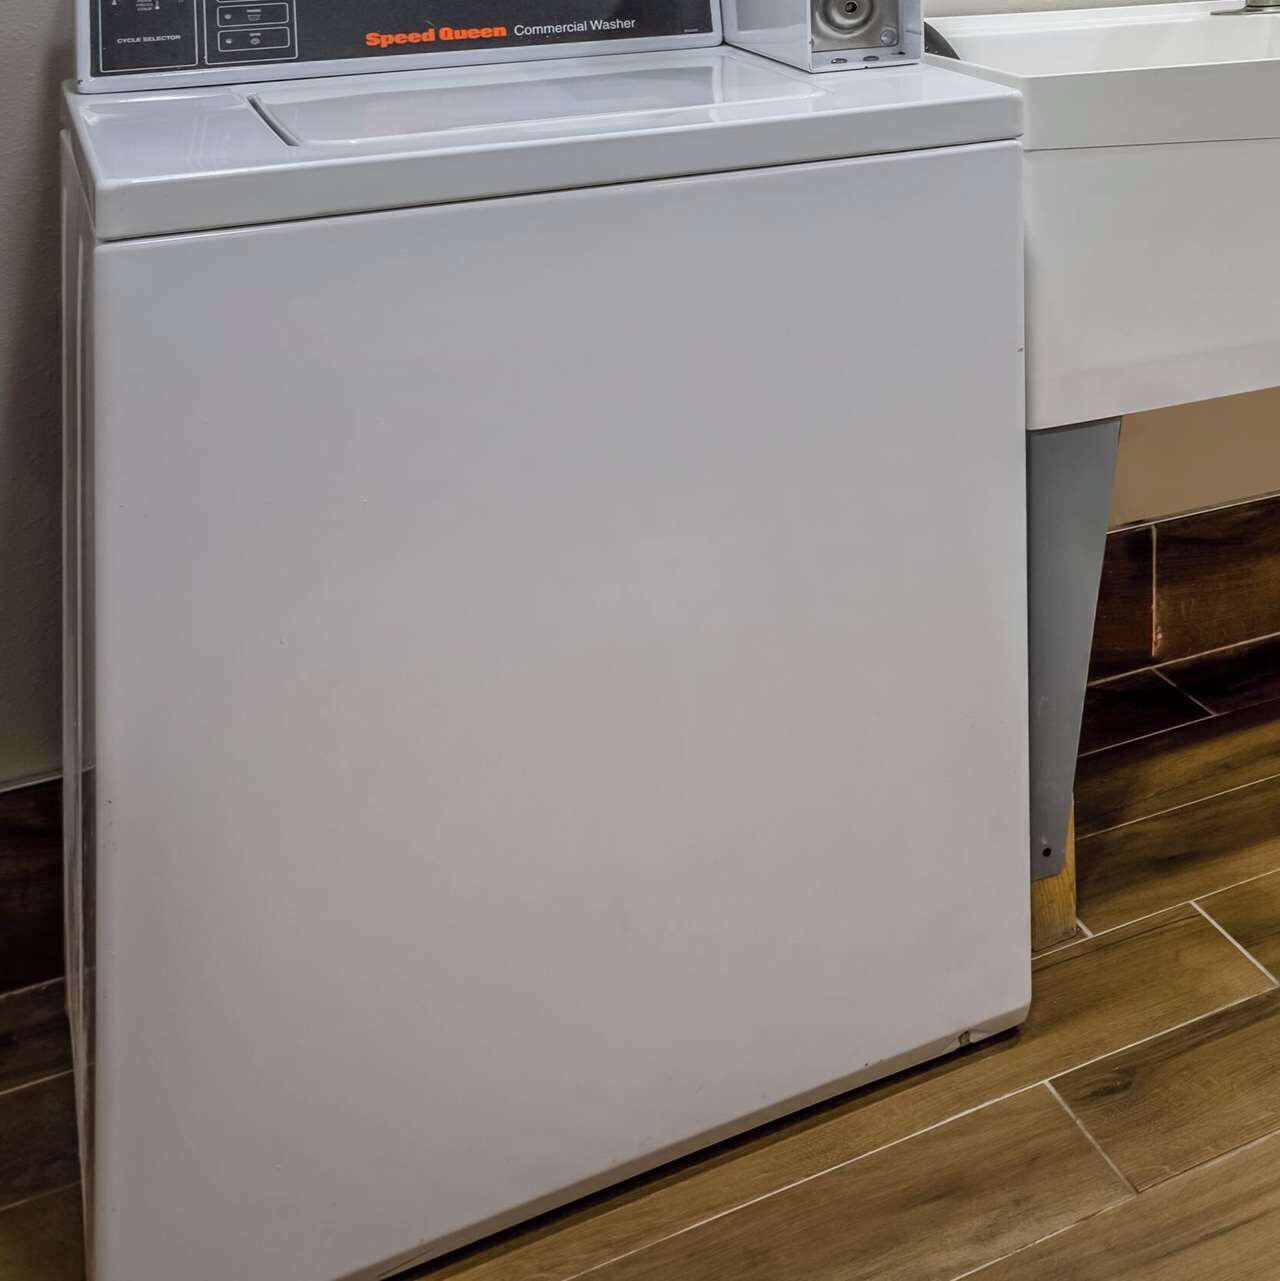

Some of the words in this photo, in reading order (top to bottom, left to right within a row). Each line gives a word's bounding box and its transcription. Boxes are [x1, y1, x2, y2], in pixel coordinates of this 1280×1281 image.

[143, 34, 181, 42] SELECTOR
[365, 28, 436, 48] Speed
[438, 24, 508, 41] Queen
[514, 20, 588, 37] Commercial
[590, 17, 637, 31] Washer
